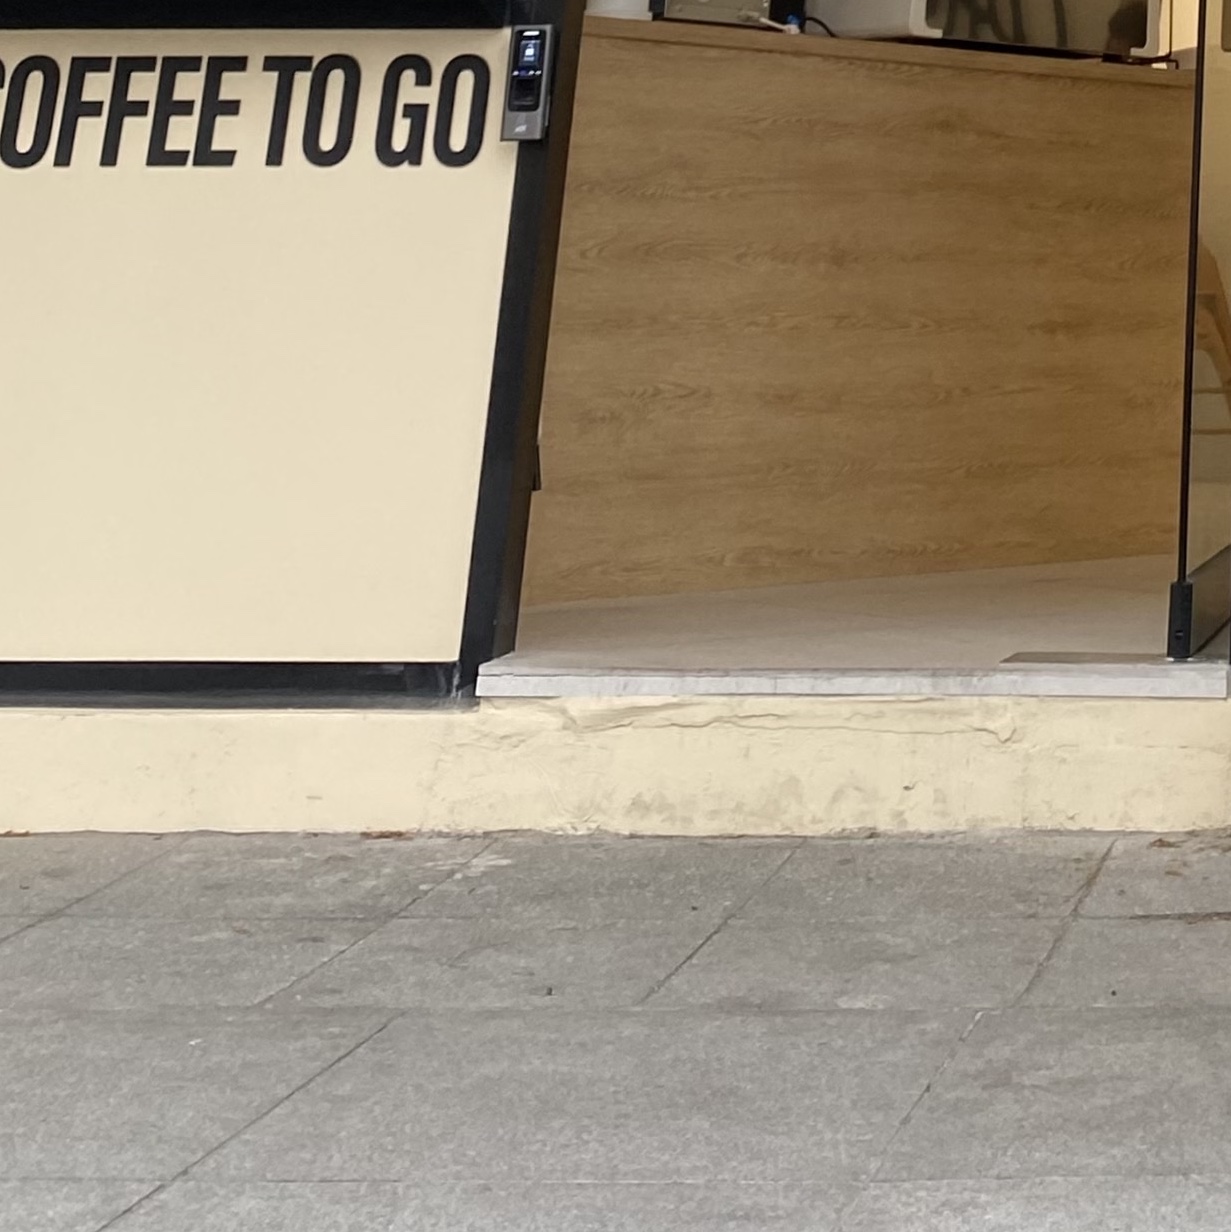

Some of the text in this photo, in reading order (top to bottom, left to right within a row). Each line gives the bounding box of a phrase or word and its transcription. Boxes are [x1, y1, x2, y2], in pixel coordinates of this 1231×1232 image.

[0, 54, 491, 168] OFFEE TO GO
